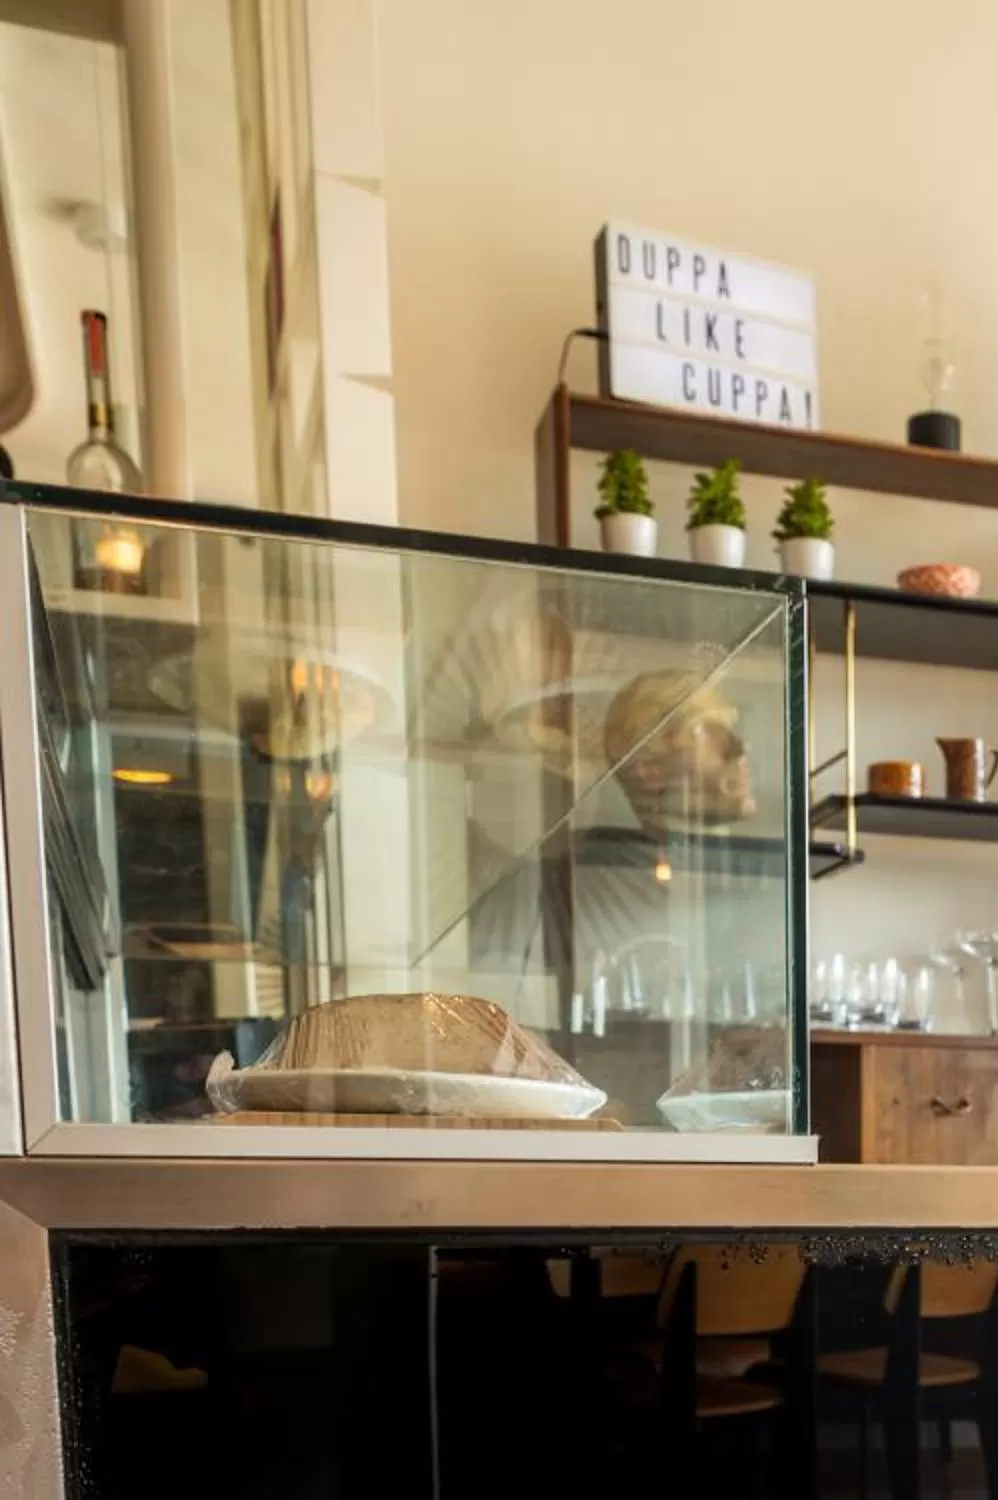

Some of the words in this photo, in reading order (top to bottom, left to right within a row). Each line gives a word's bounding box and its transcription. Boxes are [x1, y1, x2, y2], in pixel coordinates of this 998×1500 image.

[617, 233, 730, 298] DUPPA
[656, 302, 746, 358] LIKE
[682, 362, 812, 428] CUPPA!
